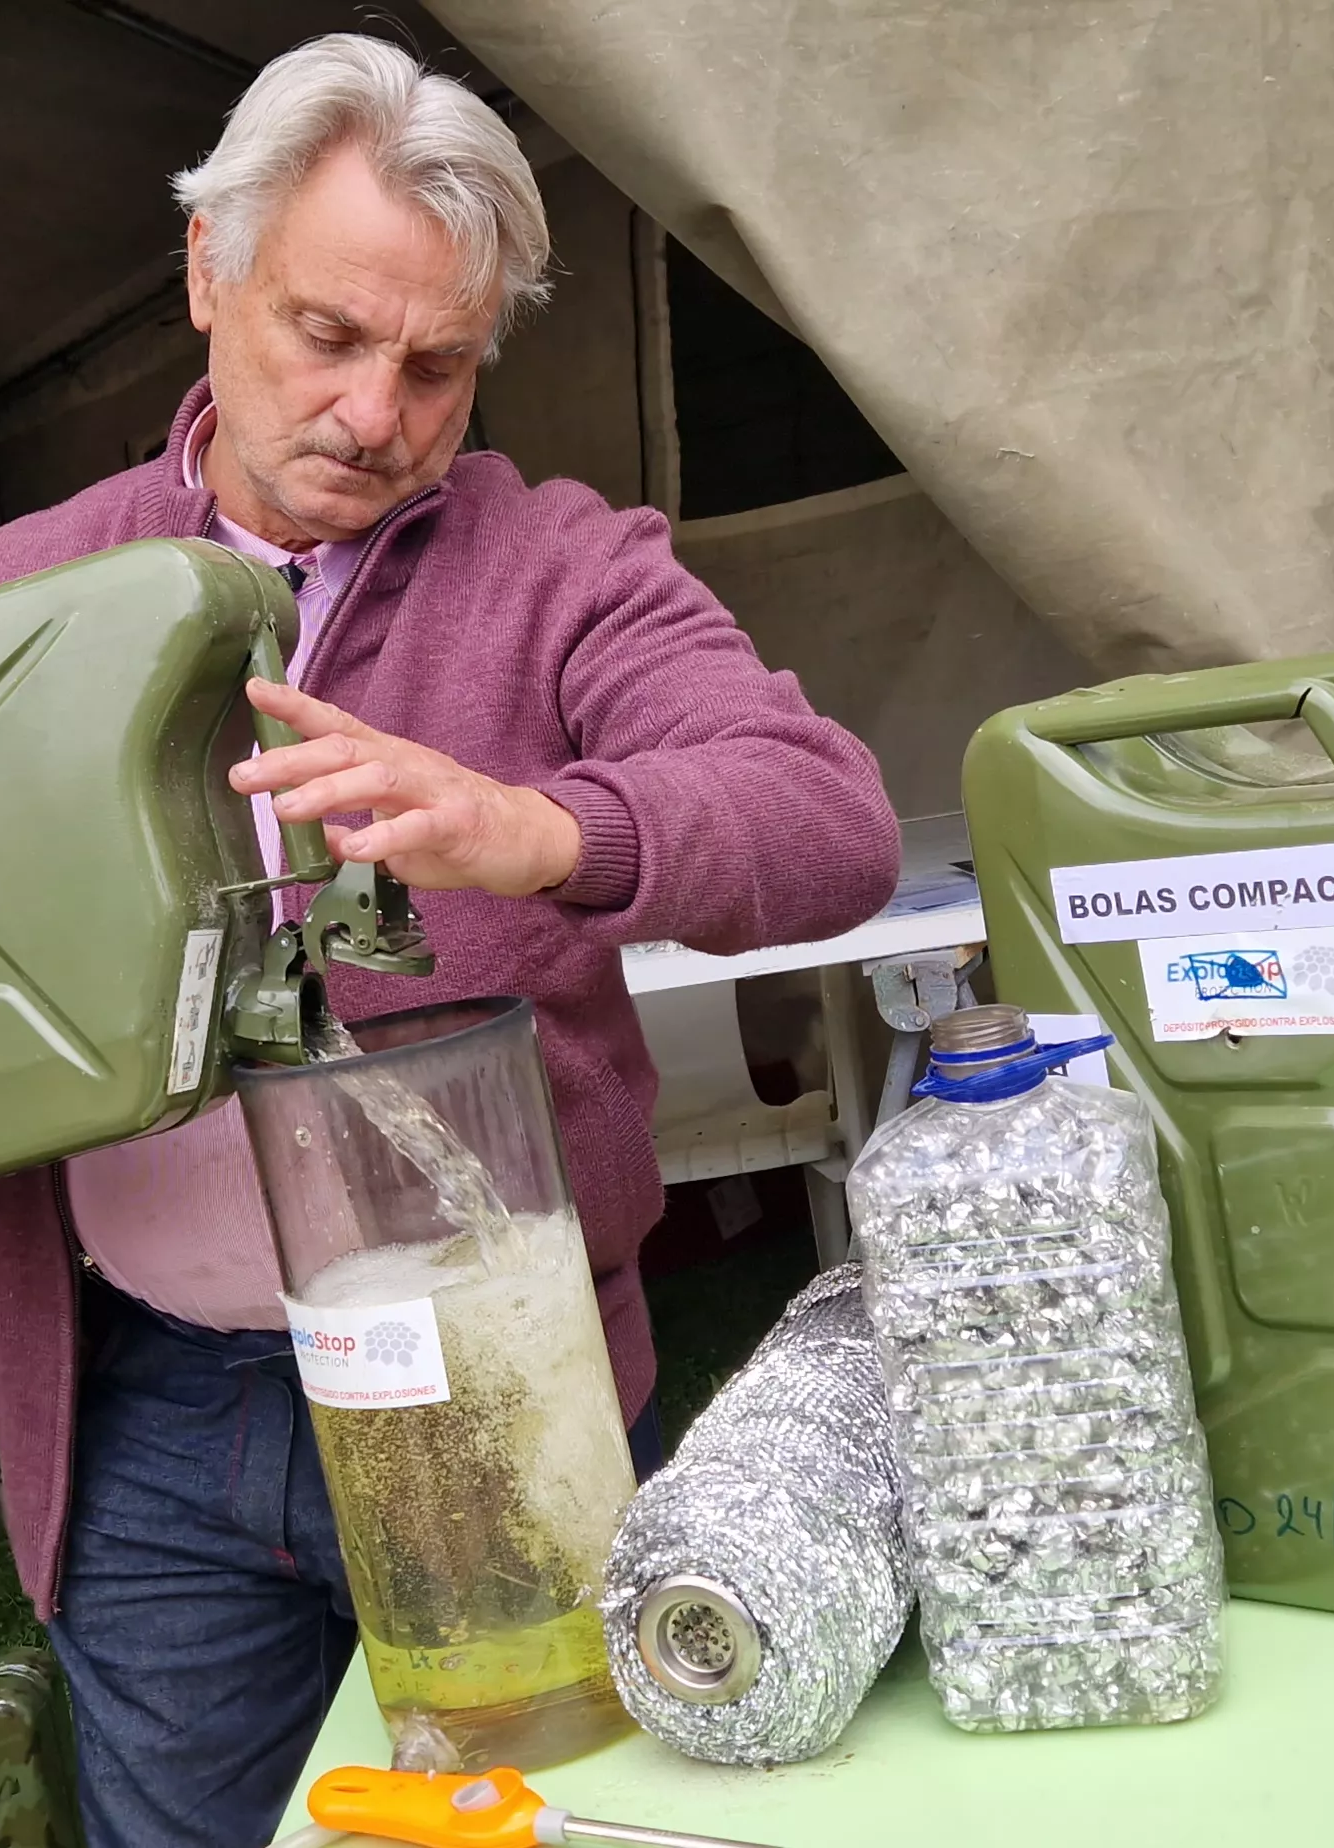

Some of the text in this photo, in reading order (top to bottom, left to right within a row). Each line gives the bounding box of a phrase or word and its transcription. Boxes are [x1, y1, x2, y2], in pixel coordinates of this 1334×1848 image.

[1068, 887, 1178, 920] BOLAS
[1167, 960, 1283, 982] Exploop
[1259, 1016, 1297, 1028] CONTRA
[372, 1384, 437, 1401] EXPLOSIONES
